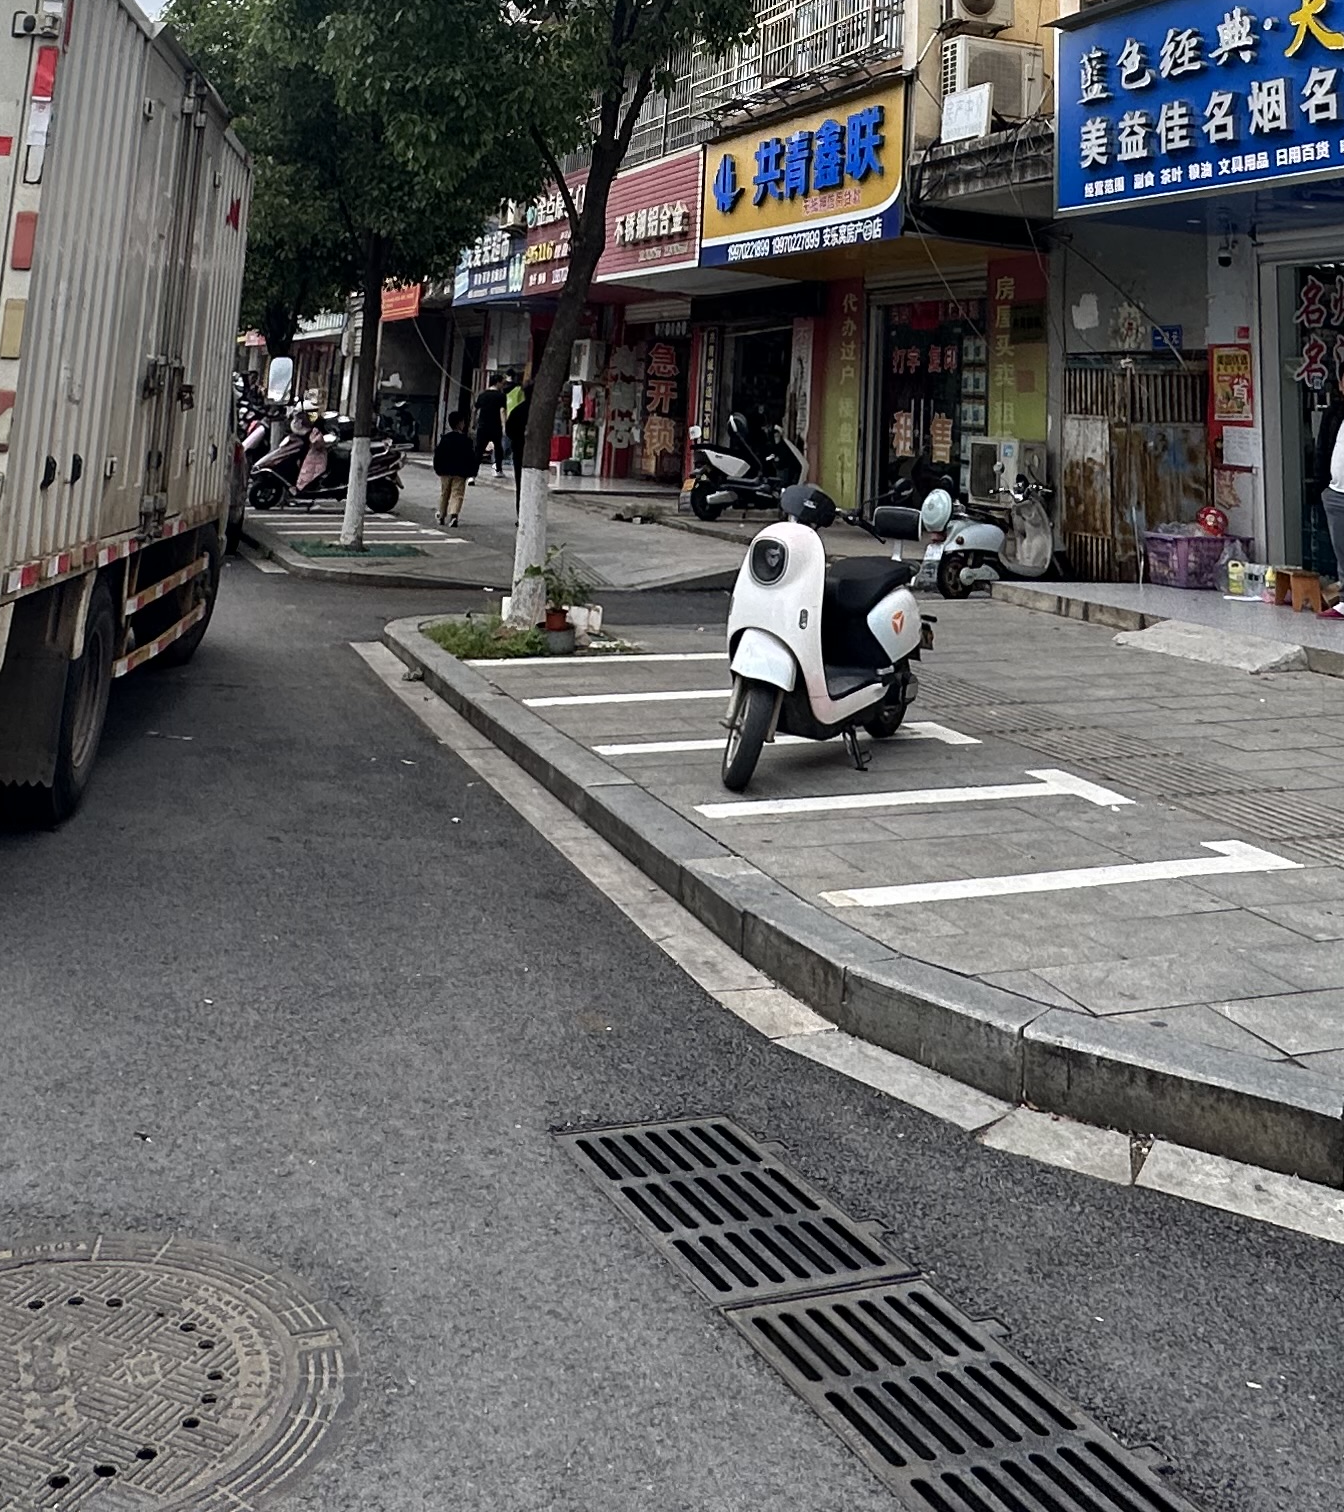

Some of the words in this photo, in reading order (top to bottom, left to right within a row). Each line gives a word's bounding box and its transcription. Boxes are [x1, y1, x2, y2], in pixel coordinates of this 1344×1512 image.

[752, 105, 885, 208] 共青鑫联
[1218, 152, 1269, 176] 文具用品
[1276, 141, 1331, 167] 日用百货
[839, 292, 859, 386] 代办过户
[643, 343, 681, 457] 急开锁
